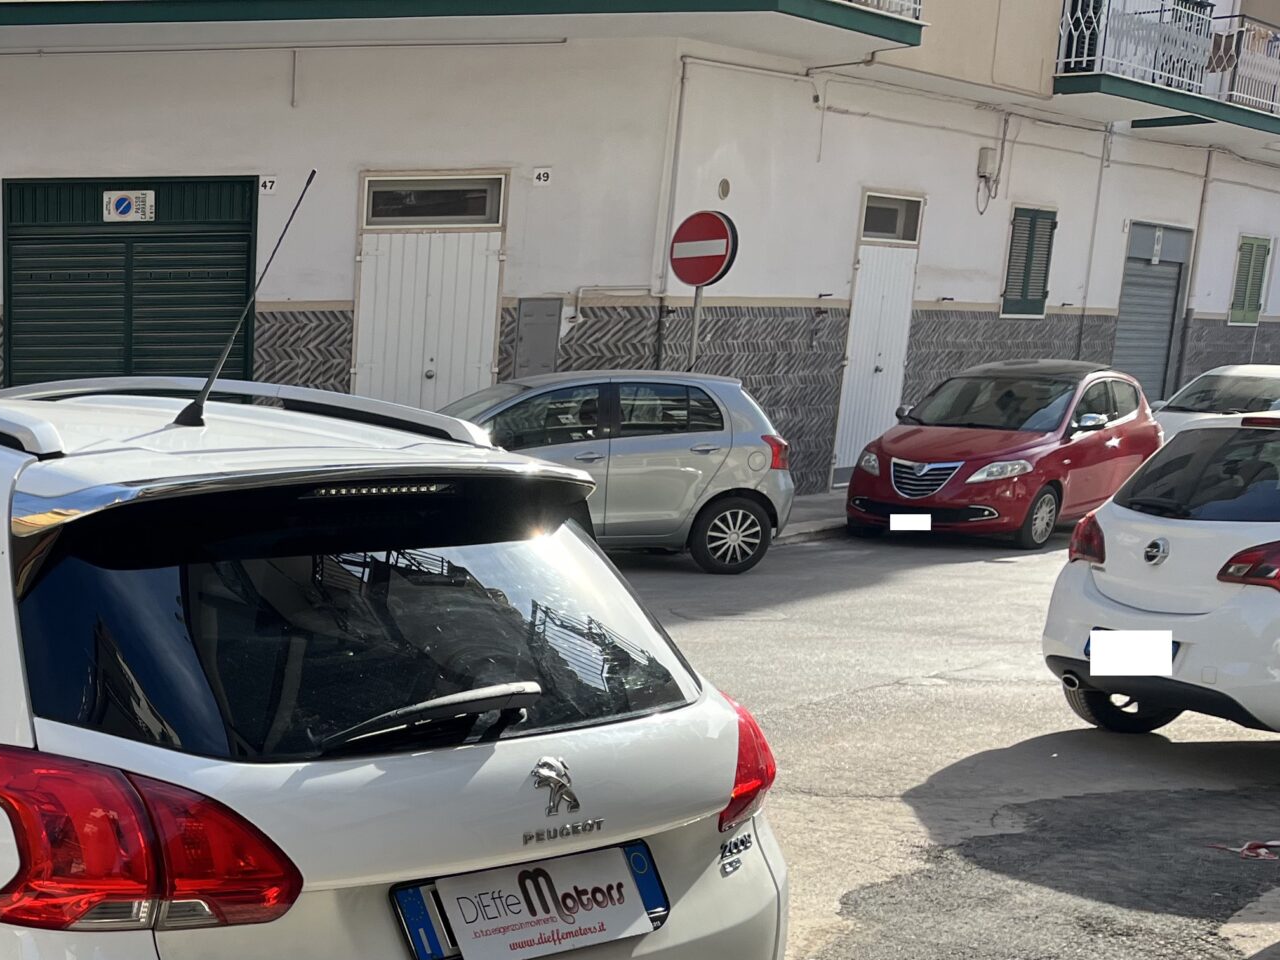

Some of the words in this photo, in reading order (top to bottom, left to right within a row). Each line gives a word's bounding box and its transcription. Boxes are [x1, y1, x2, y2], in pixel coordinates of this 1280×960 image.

[261, 180, 275, 190] 47
[536, 172, 549, 182] 49
[523, 818, 605, 846] PEUGEOT
[720, 833, 753, 860] 2008
[517, 867, 624, 925] Motors
[509, 921, 607, 951] www.dieffemotors.it
